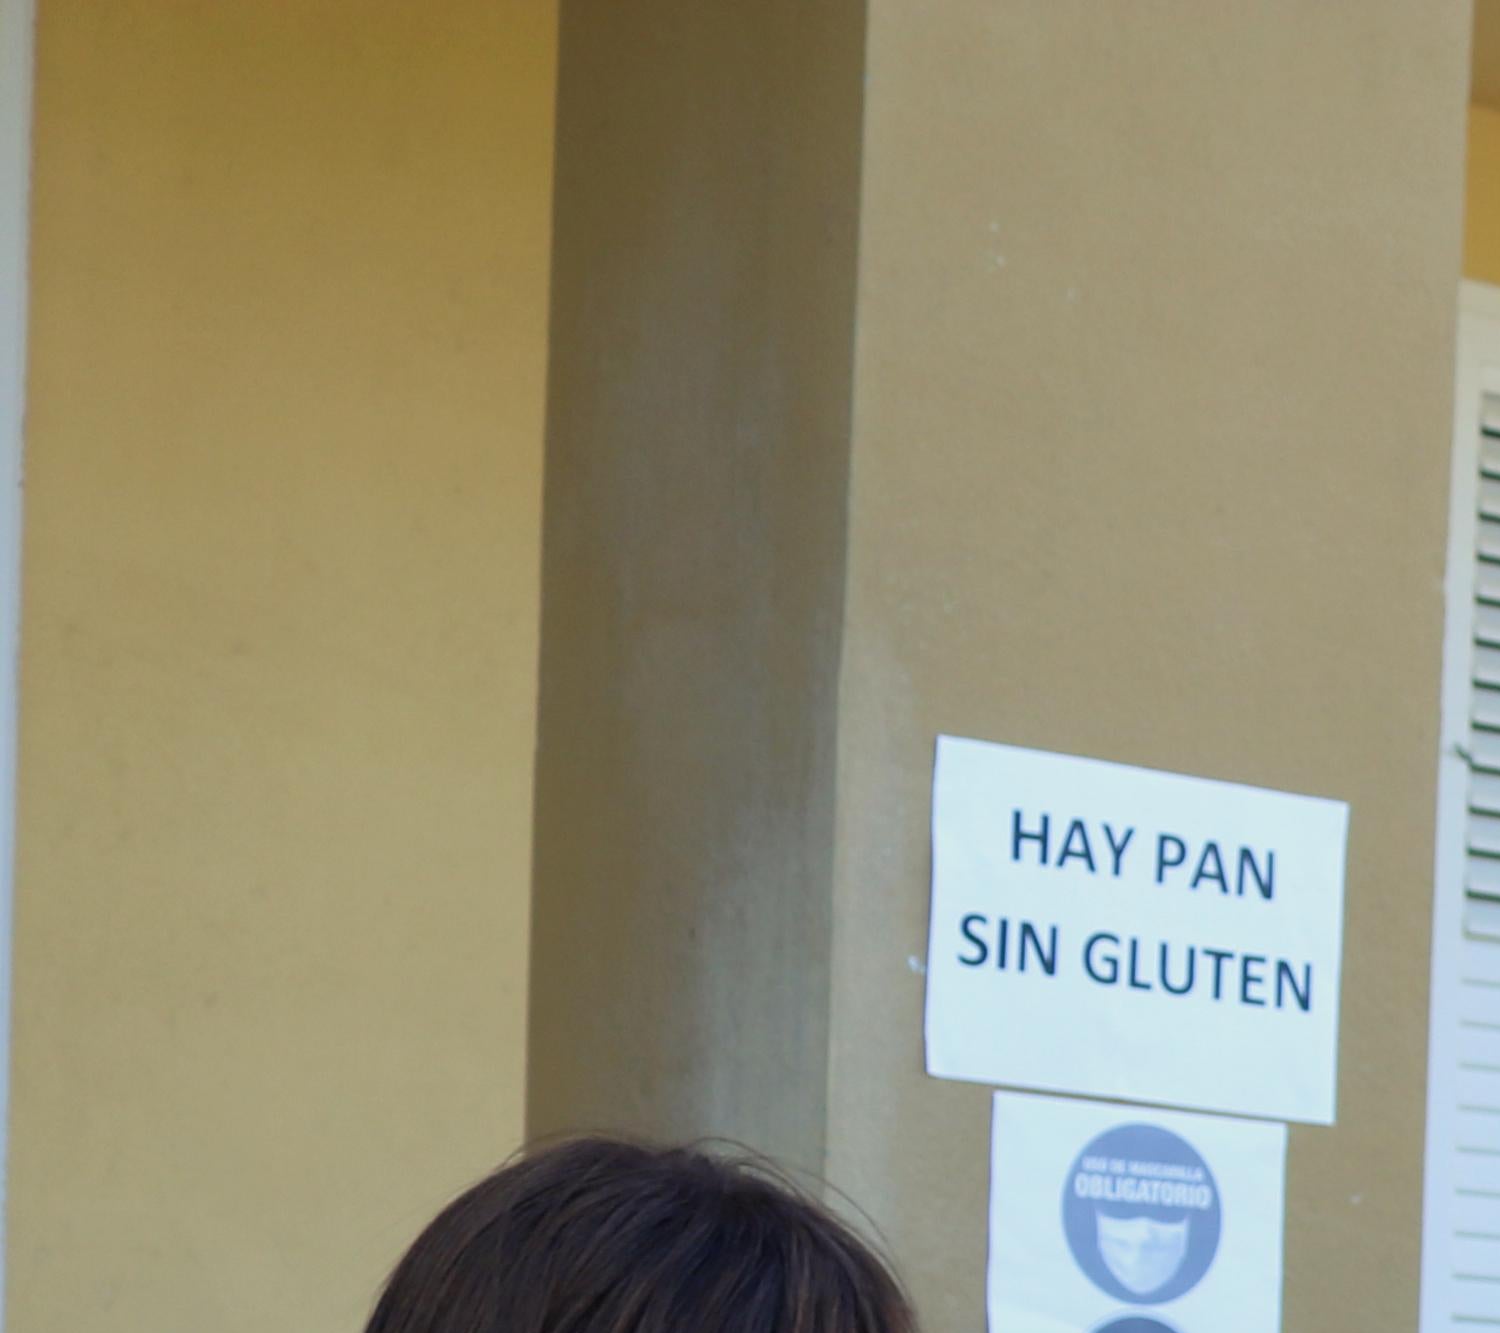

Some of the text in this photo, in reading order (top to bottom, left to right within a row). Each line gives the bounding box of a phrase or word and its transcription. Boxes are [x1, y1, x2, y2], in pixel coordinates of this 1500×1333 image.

[1011, 809, 1275, 900] HAY PAN
[957, 913, 1312, 1013] SIN GLUTEN
[1074, 1172, 1212, 1210] OBLIGATORIO
